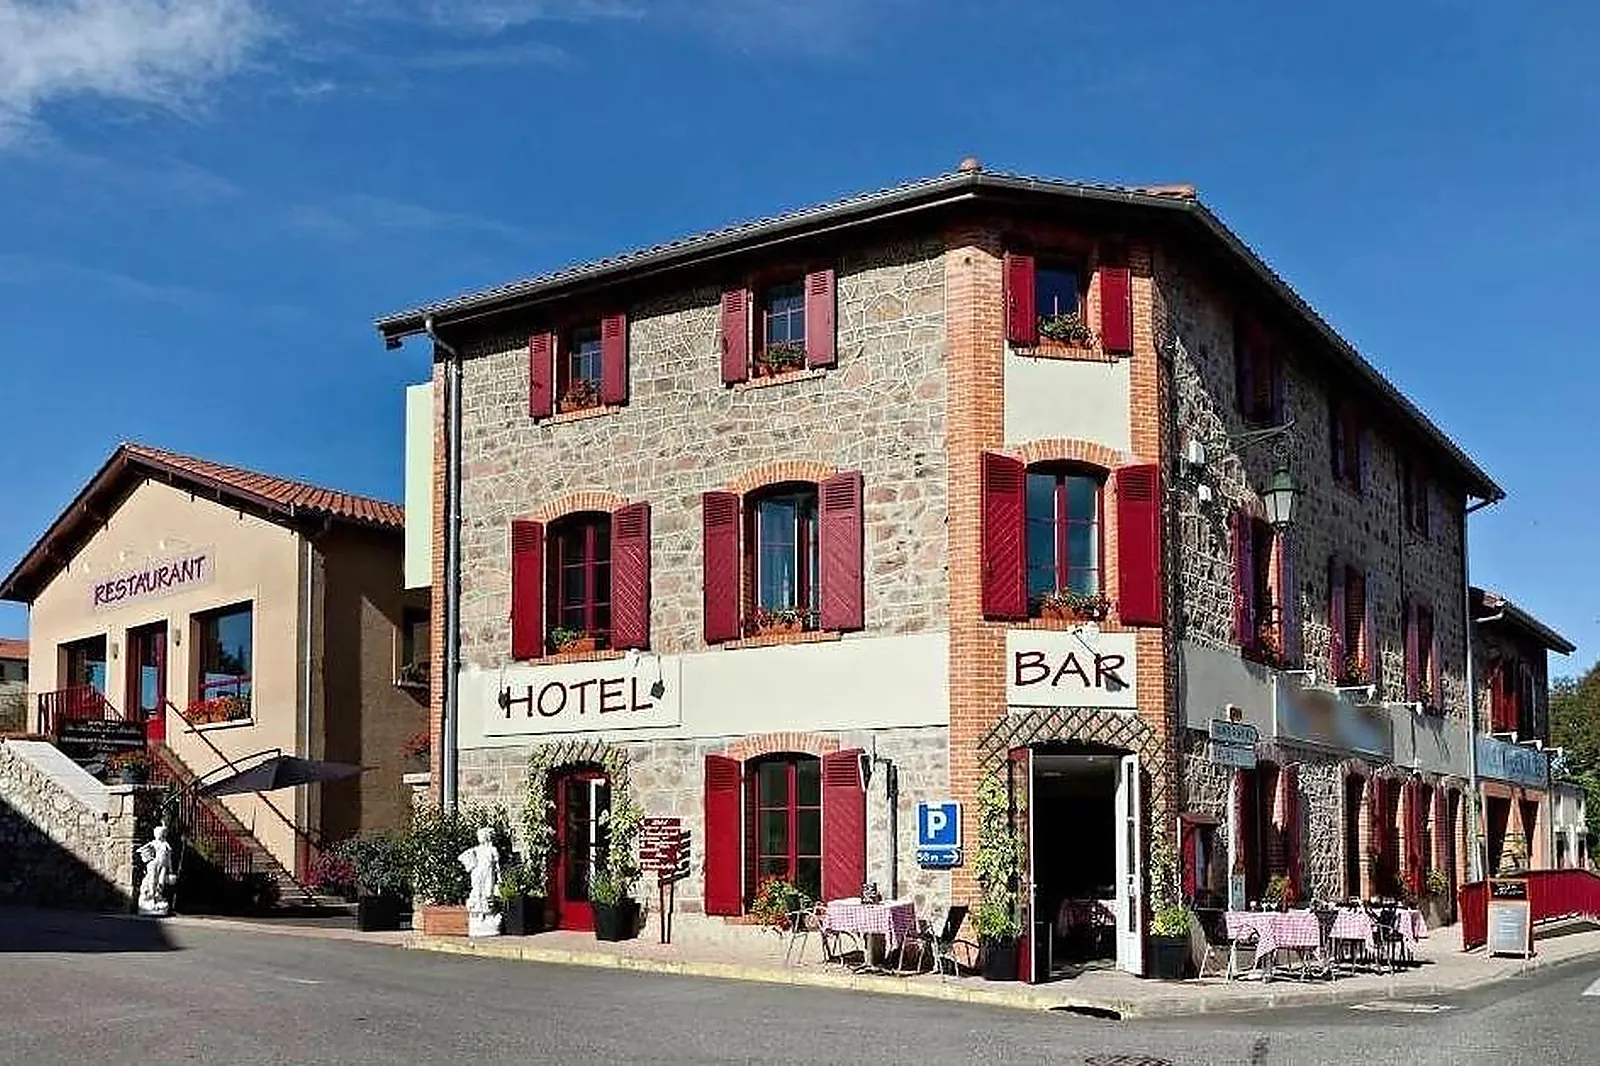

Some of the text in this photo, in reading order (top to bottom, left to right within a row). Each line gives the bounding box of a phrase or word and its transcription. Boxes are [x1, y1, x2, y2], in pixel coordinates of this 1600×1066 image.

[95, 556, 205, 605] RESTAURANT
[1015, 652, 1130, 687] BAR
[506, 677, 653, 718] HOTEL
[927, 810, 948, 839] P
